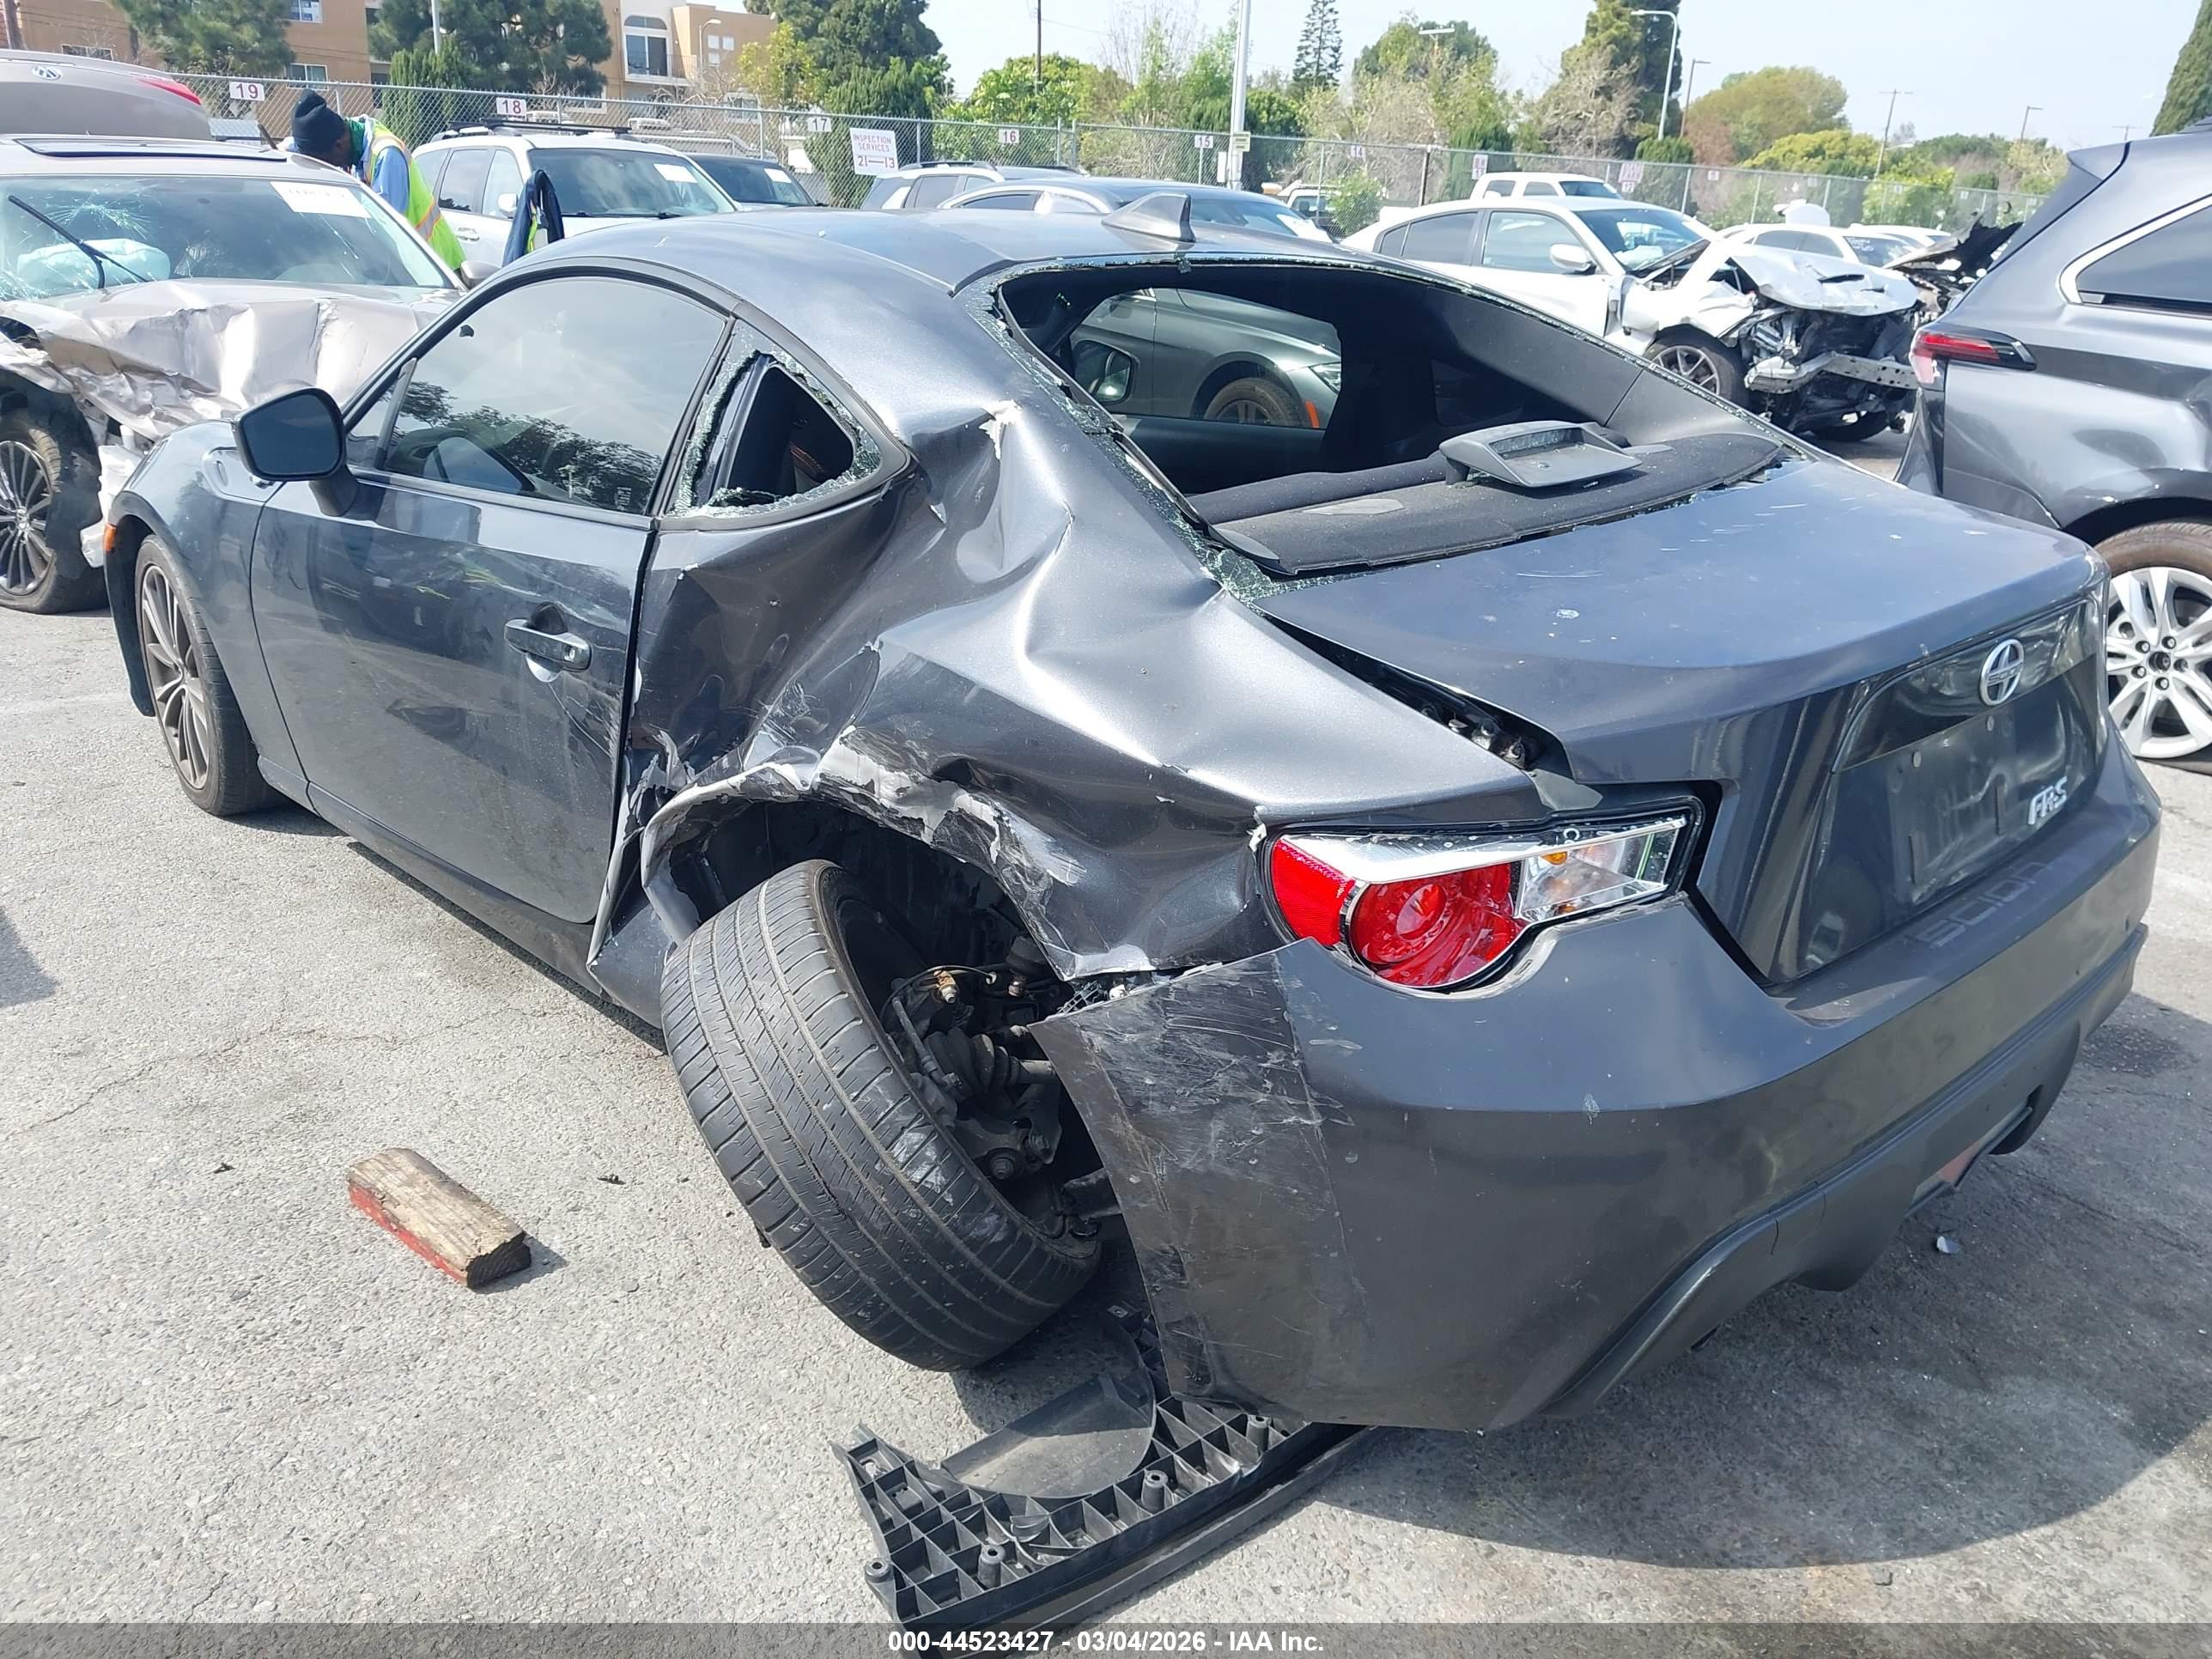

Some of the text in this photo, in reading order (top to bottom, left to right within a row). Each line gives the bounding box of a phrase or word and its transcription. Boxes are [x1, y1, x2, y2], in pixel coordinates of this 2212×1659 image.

[236, 83, 258, 99] 19
[501, 100, 521, 114] 18
[812, 118, 827, 131] 17
[853, 134, 891, 144] INSPECTION
[1003, 131, 1017, 143] 16
[1197, 137, 1210, 148] 15
[859, 143, 890, 152] SERVICES
